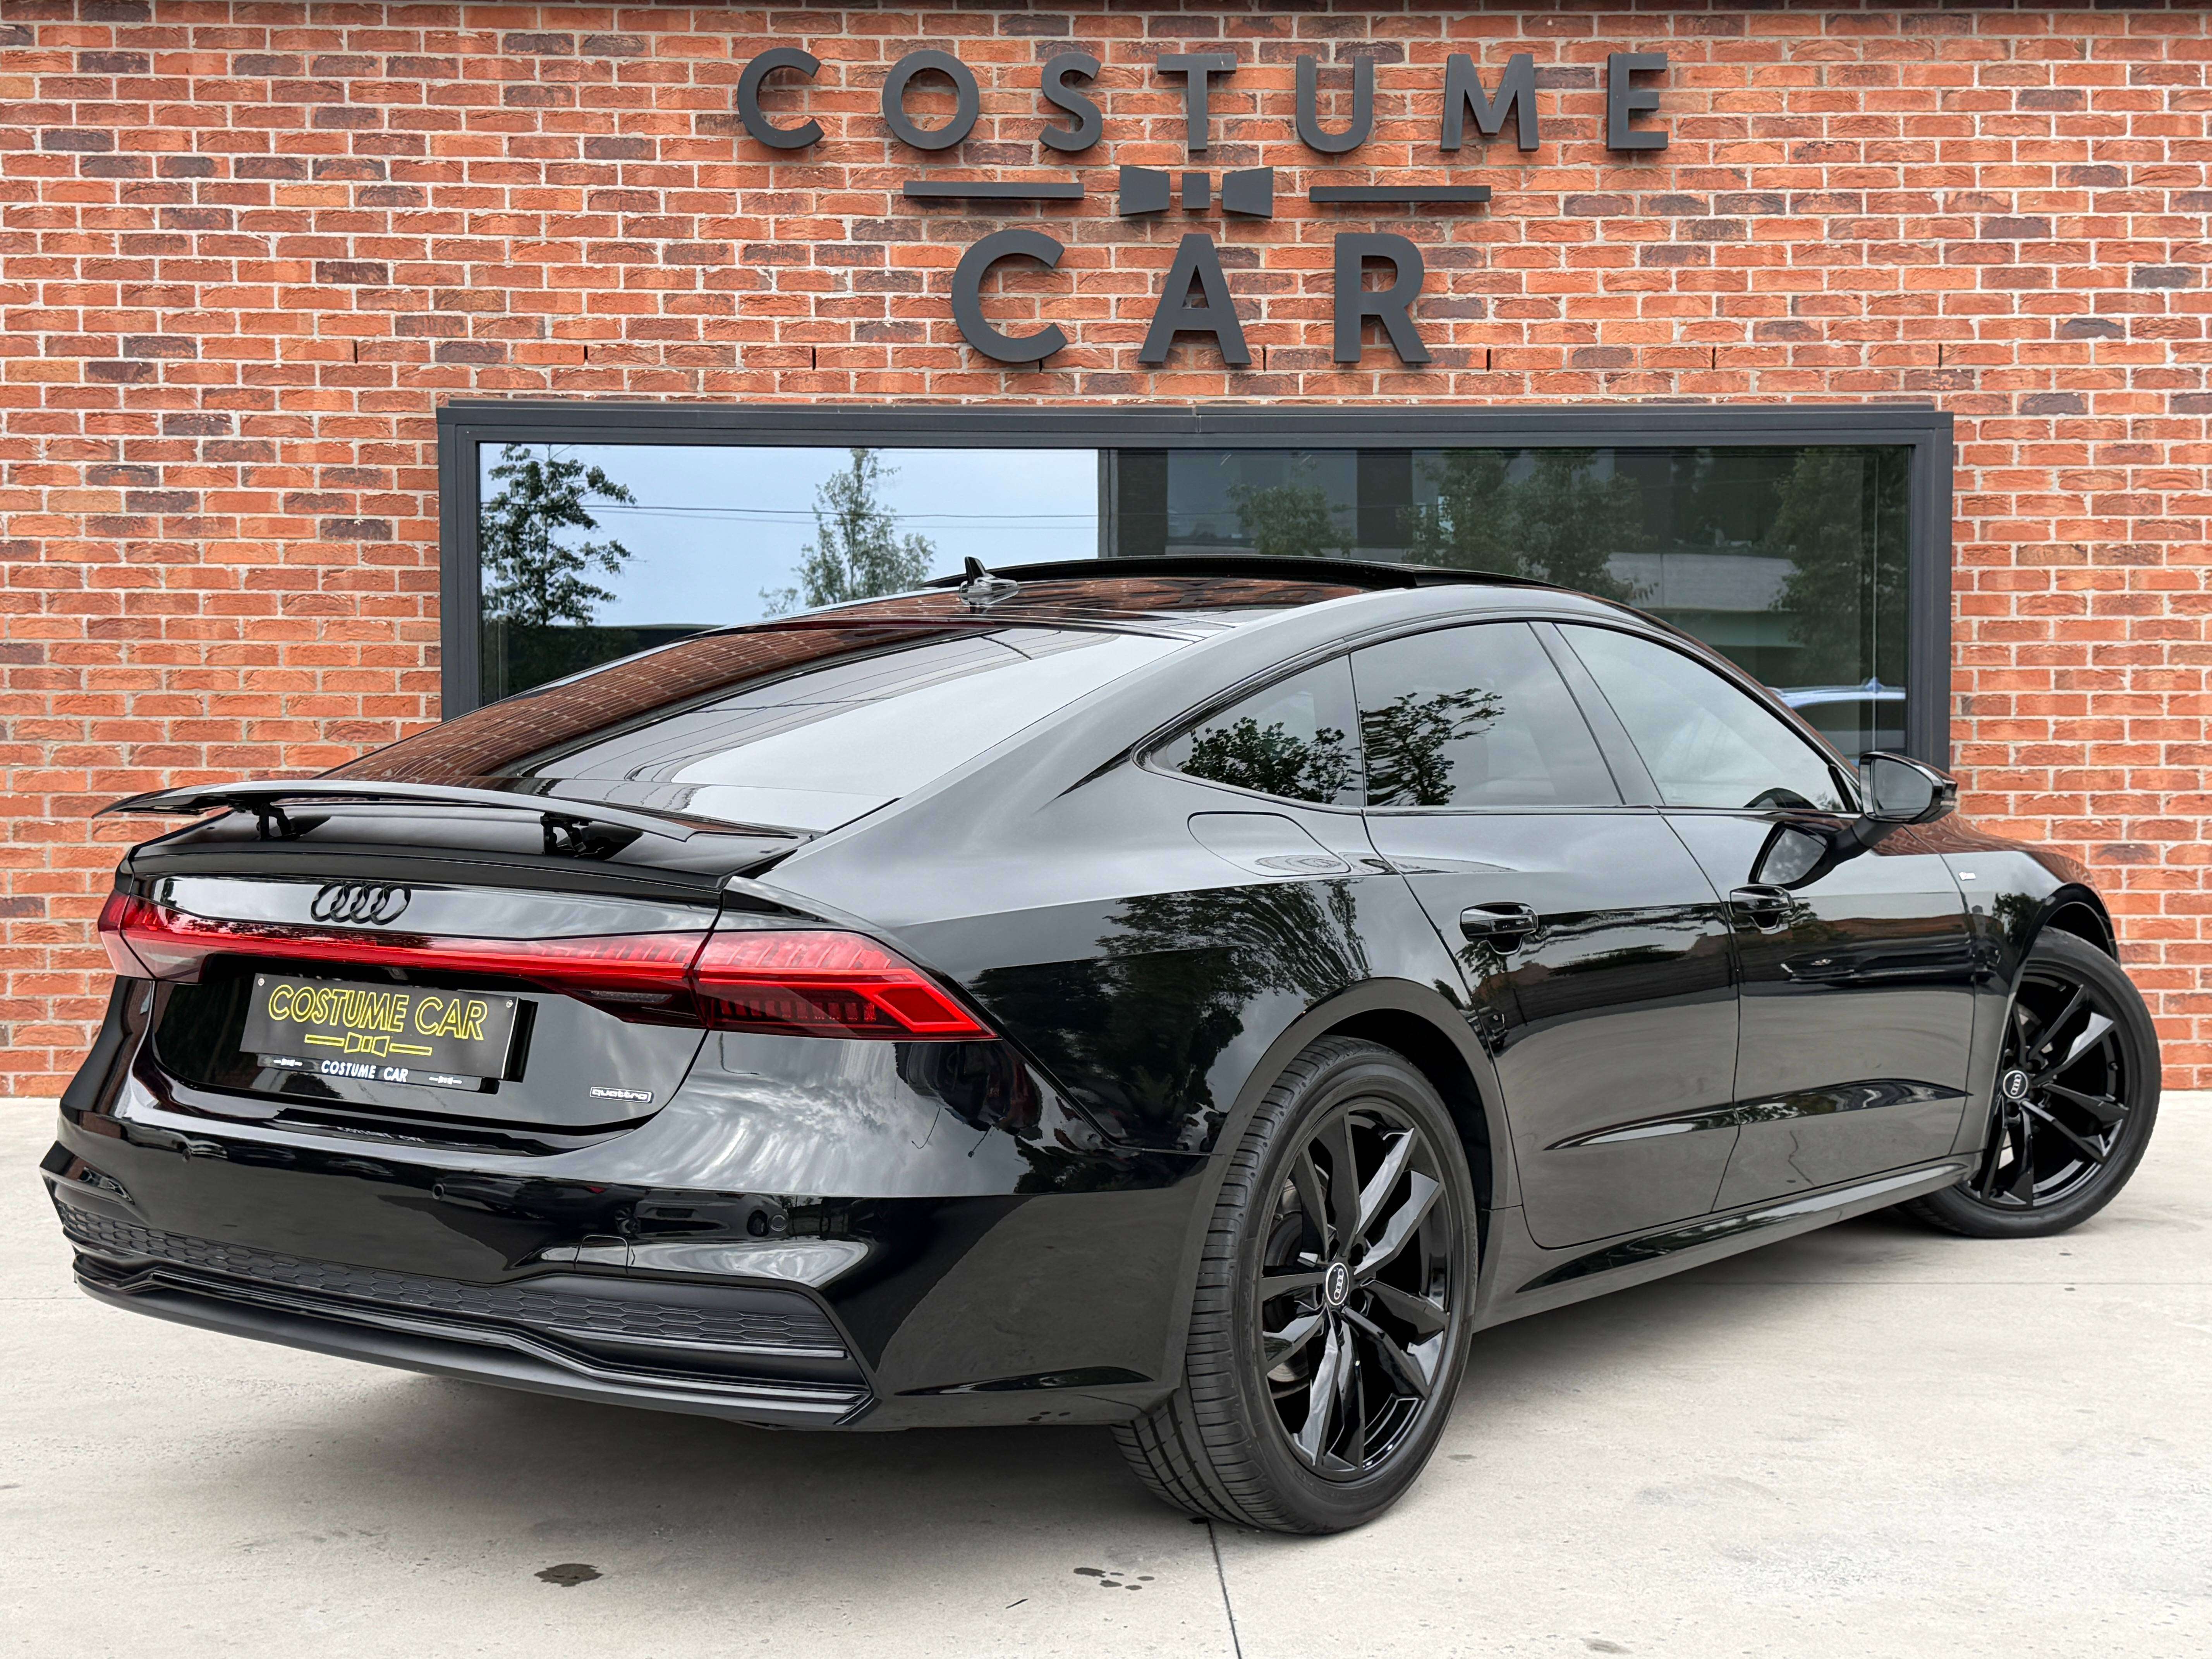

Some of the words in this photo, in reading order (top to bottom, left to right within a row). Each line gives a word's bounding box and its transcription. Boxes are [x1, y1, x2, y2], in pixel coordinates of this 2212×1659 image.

[737, 47, 1668, 154] COSTUME
[951, 228, 1432, 365] CAR
[269, 984, 409, 1032] COSTUME
[415, 996, 488, 1041] CAR
[321, 1060, 376, 1079] COSTUME
[383, 1067, 409, 1082] CAR
[592, 1089, 647, 1100] quattro
